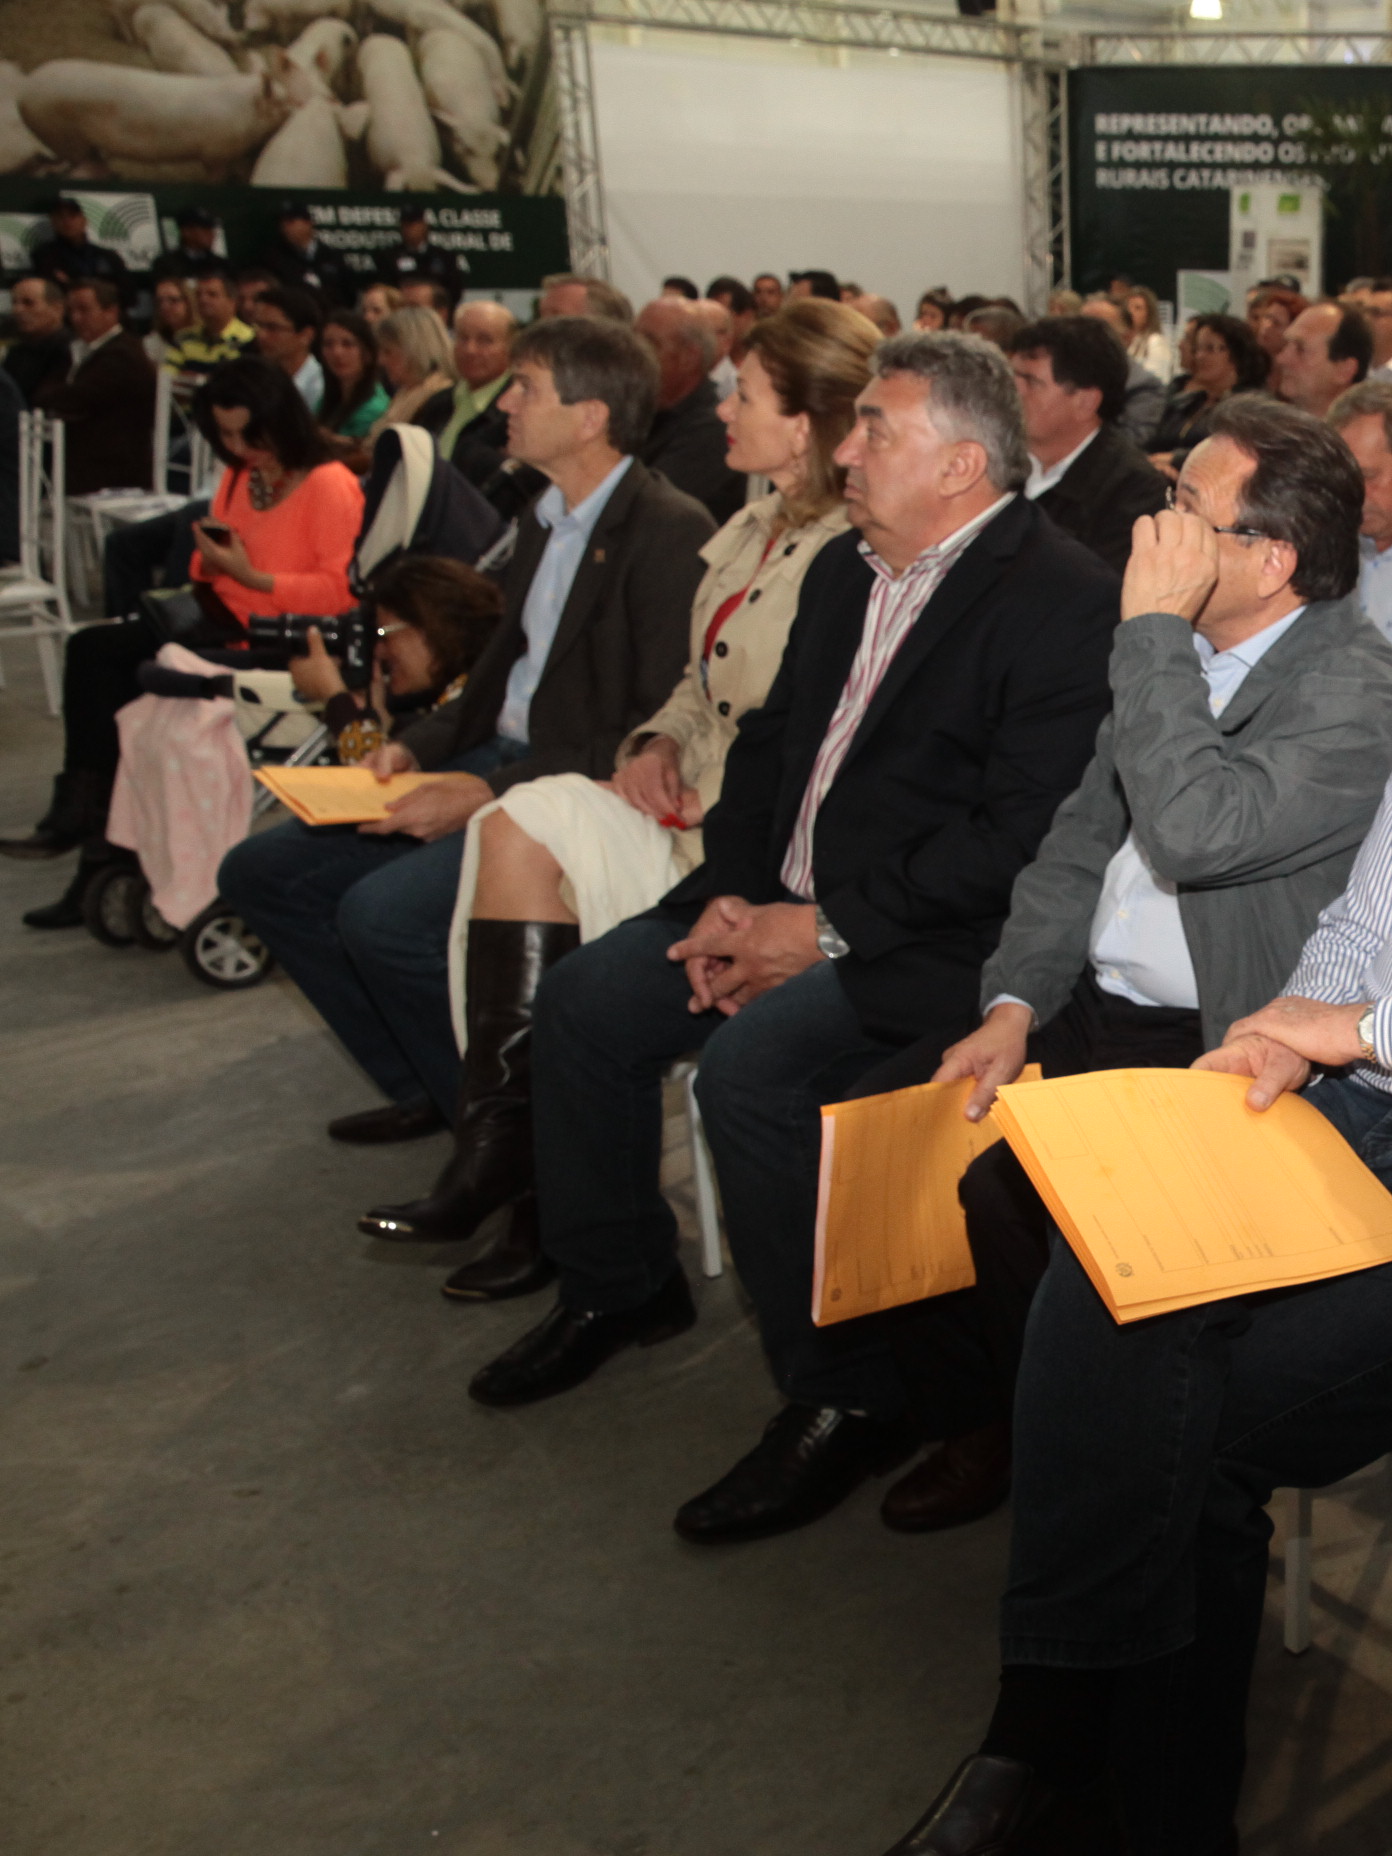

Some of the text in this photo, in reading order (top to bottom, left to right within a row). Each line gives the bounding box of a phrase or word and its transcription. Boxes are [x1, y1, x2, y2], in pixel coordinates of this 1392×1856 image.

[1095, 112, 1280, 139] REPRESENTANDO,
[1095, 140, 1108, 162] E
[1111, 140, 1275, 163] FORTALECENDO
[1096, 167, 1170, 189] RURAIS
[338, 205, 401, 227] DEFES
[439, 208, 502, 229] CLASSE
[489, 232, 513, 251] DE
